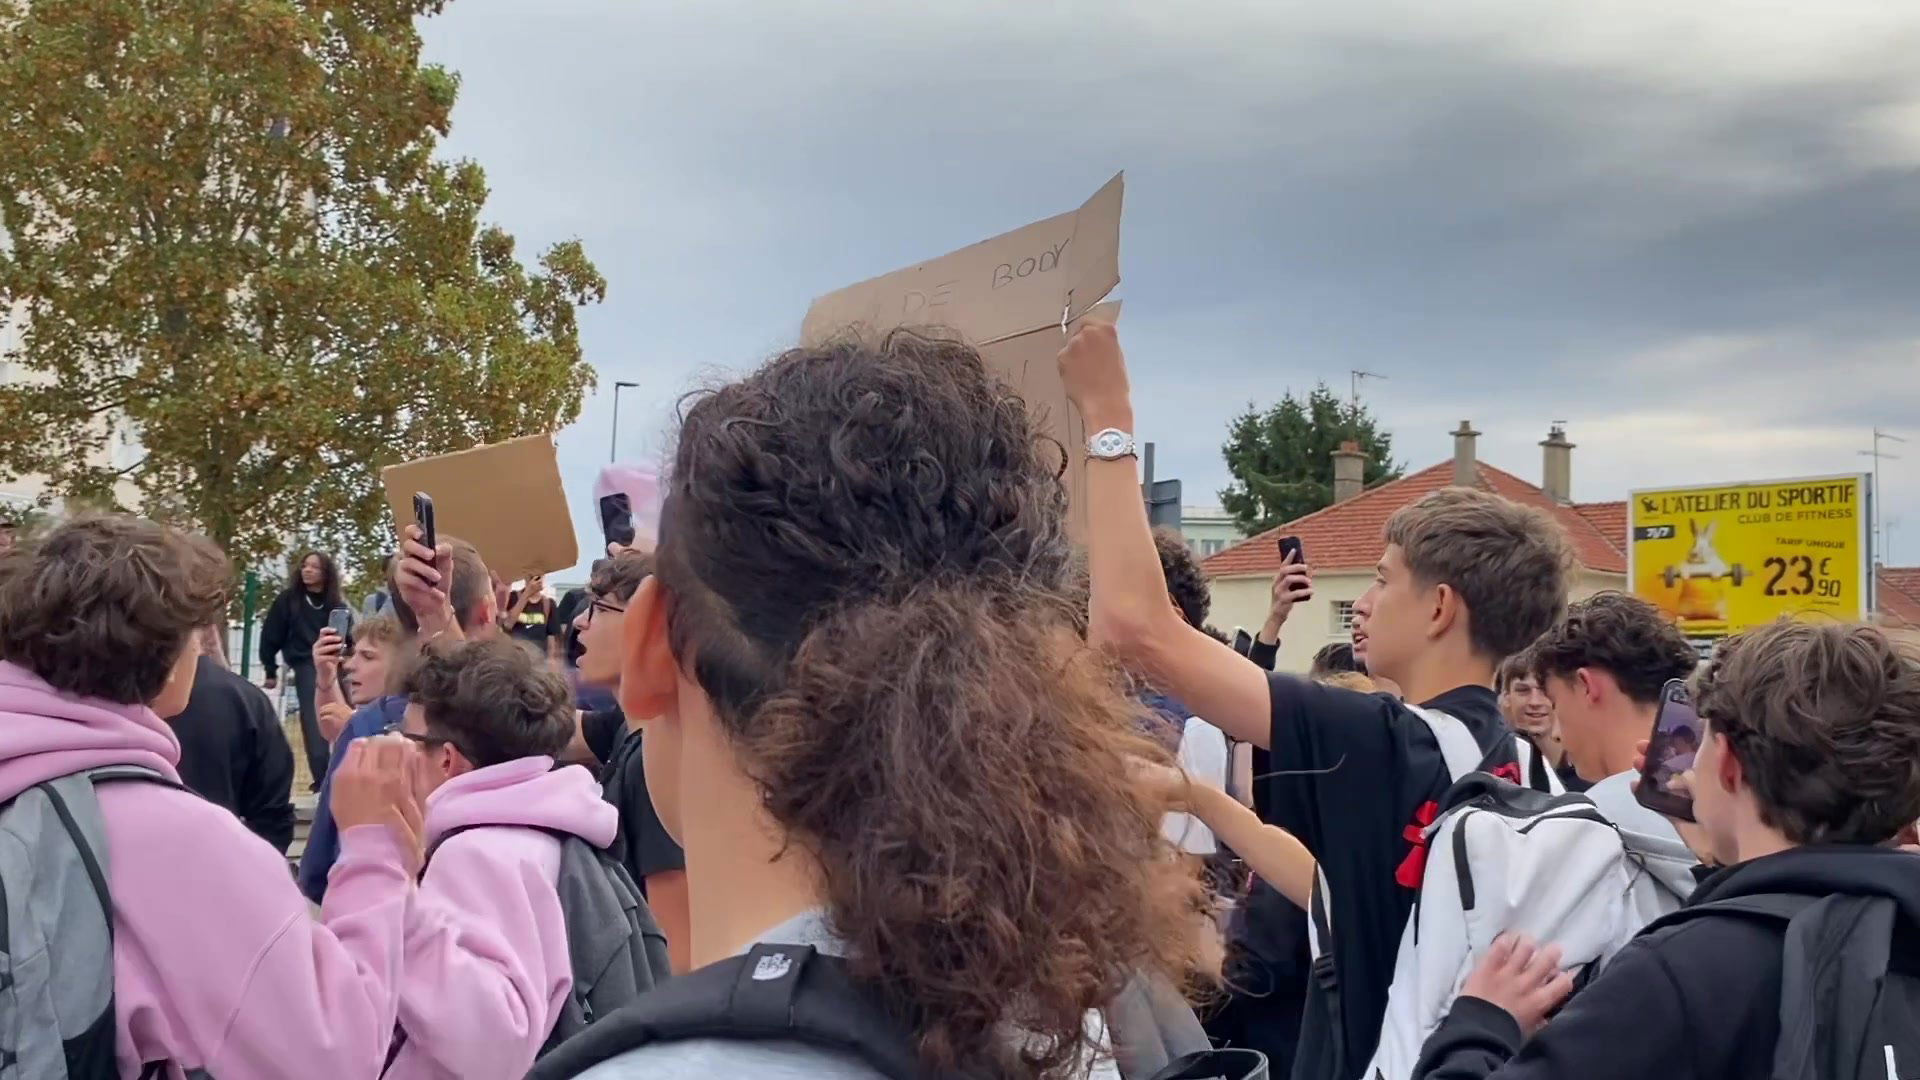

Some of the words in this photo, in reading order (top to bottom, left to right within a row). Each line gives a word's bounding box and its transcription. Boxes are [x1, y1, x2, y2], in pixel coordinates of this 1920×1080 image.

[992, 238, 1070, 289] BODY
[1662, 492, 1741, 514] L'ATELIER
[1747, 489, 1771, 509] DU
[1777, 484, 1855, 507] SPORTIF
[1738, 514, 1771, 525] CLUB
[1776, 511, 1793, 522] DE
[1797, 508, 1853, 520] FITNESS
[1764, 555, 1814, 596] 23
[1817, 579, 1841, 597] 90
